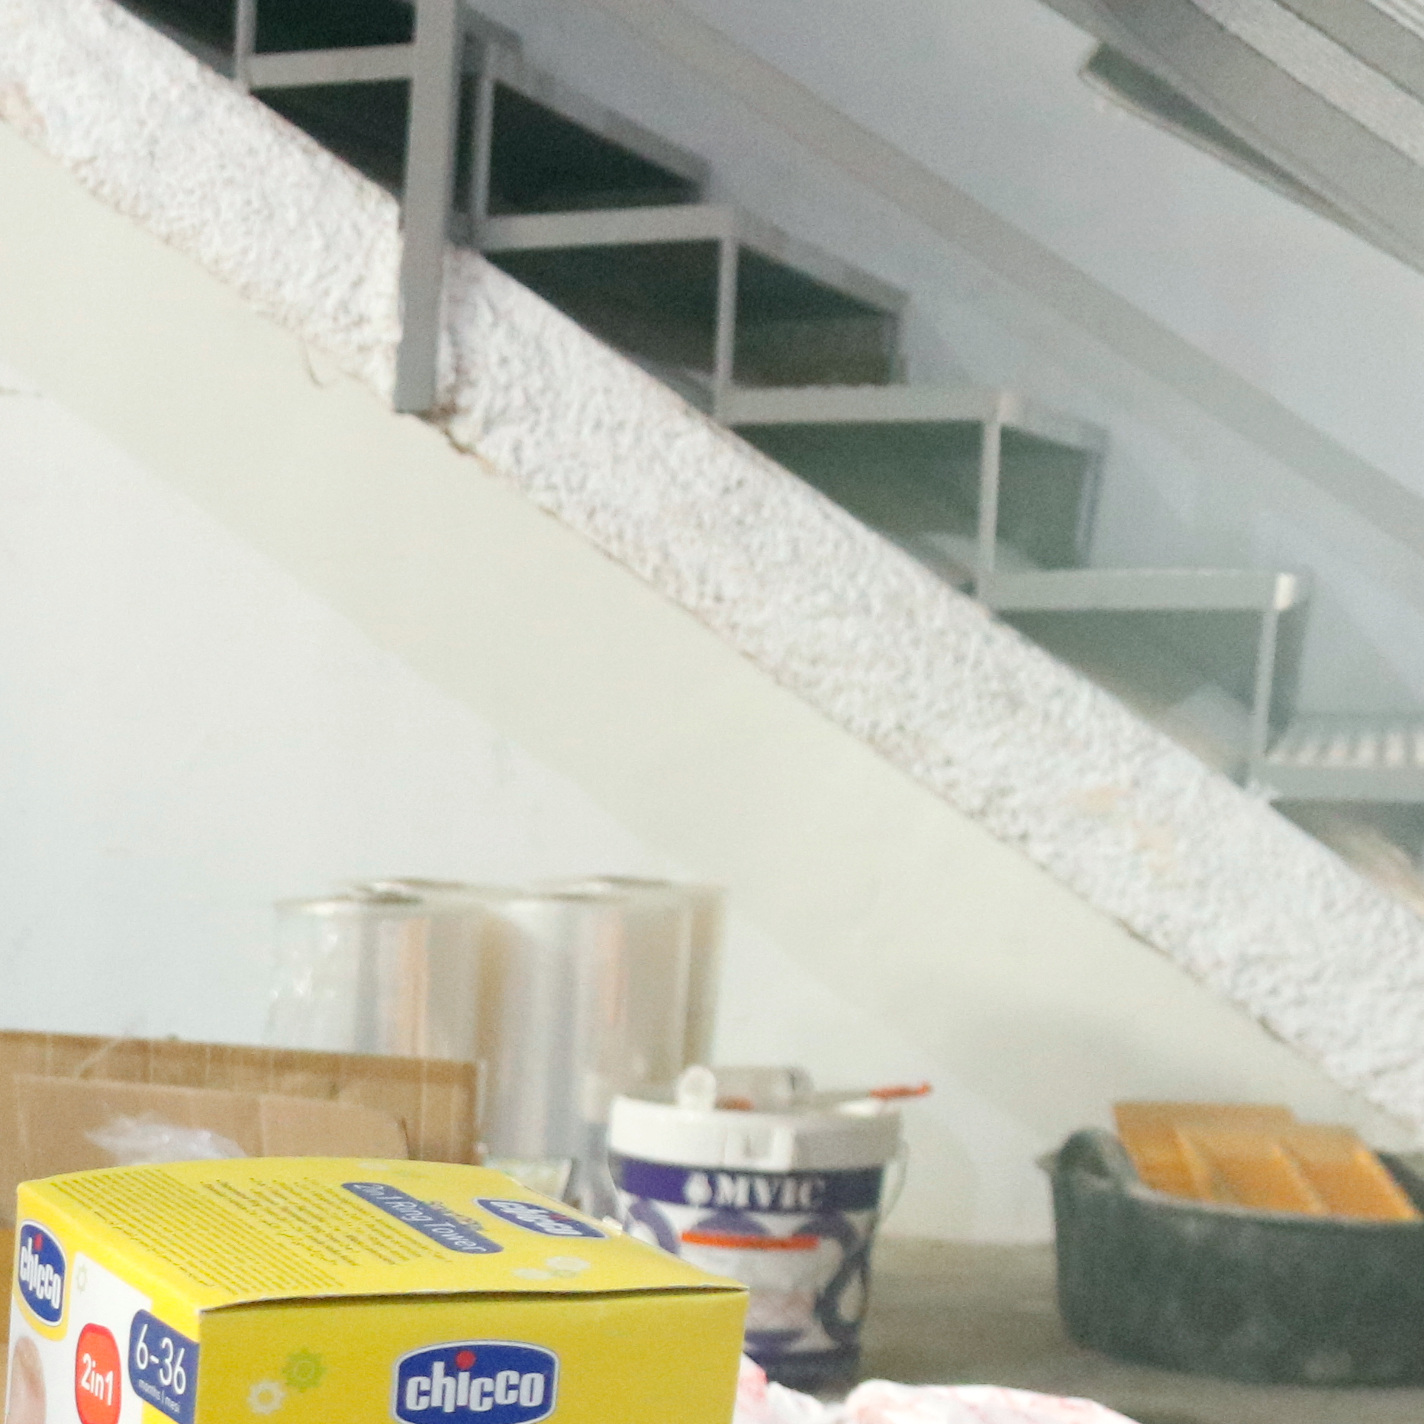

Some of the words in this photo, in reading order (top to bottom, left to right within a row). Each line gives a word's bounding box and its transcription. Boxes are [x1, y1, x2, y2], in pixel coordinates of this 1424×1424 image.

[392, 1199, 433, 1223] Ring
[424, 1222, 488, 1253] Tower
[490, 1200, 583, 1236] chicco
[19, 1231, 61, 1310] chicco
[81, 1353, 114, 1406] 2in1
[134, 1323, 187, 1396] 6-36
[405, 1350, 546, 1413] chicco
